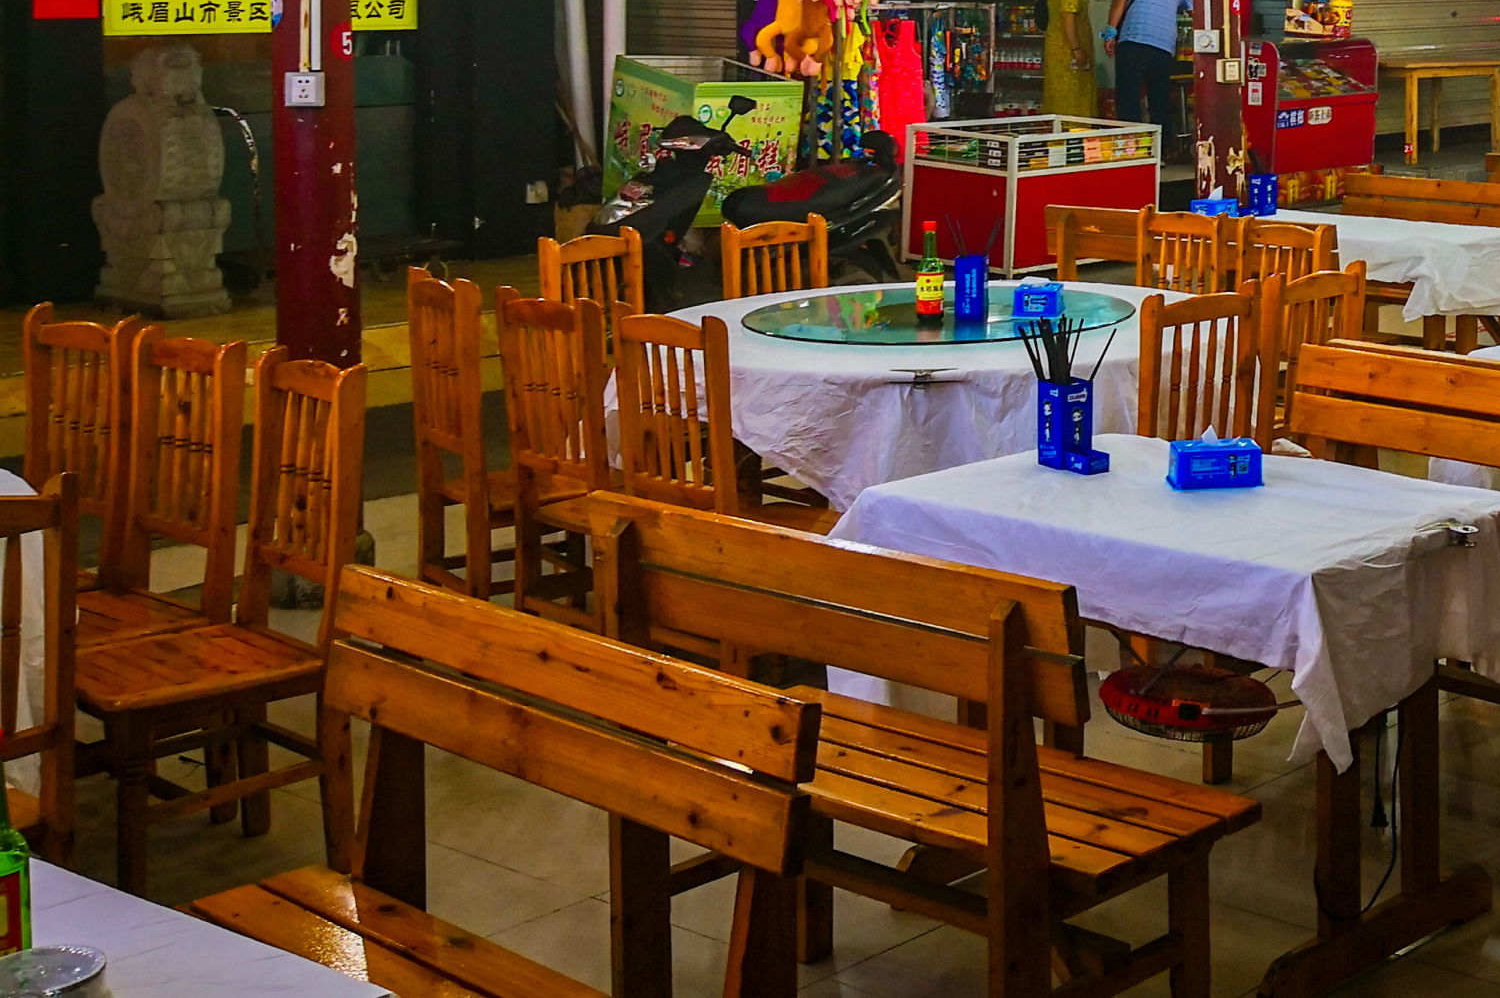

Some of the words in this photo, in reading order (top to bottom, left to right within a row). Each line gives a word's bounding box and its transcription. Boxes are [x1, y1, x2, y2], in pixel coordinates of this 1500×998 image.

[121, 0, 271, 23] 峨眉山市景区
[342, 31, 353, 55] 5
